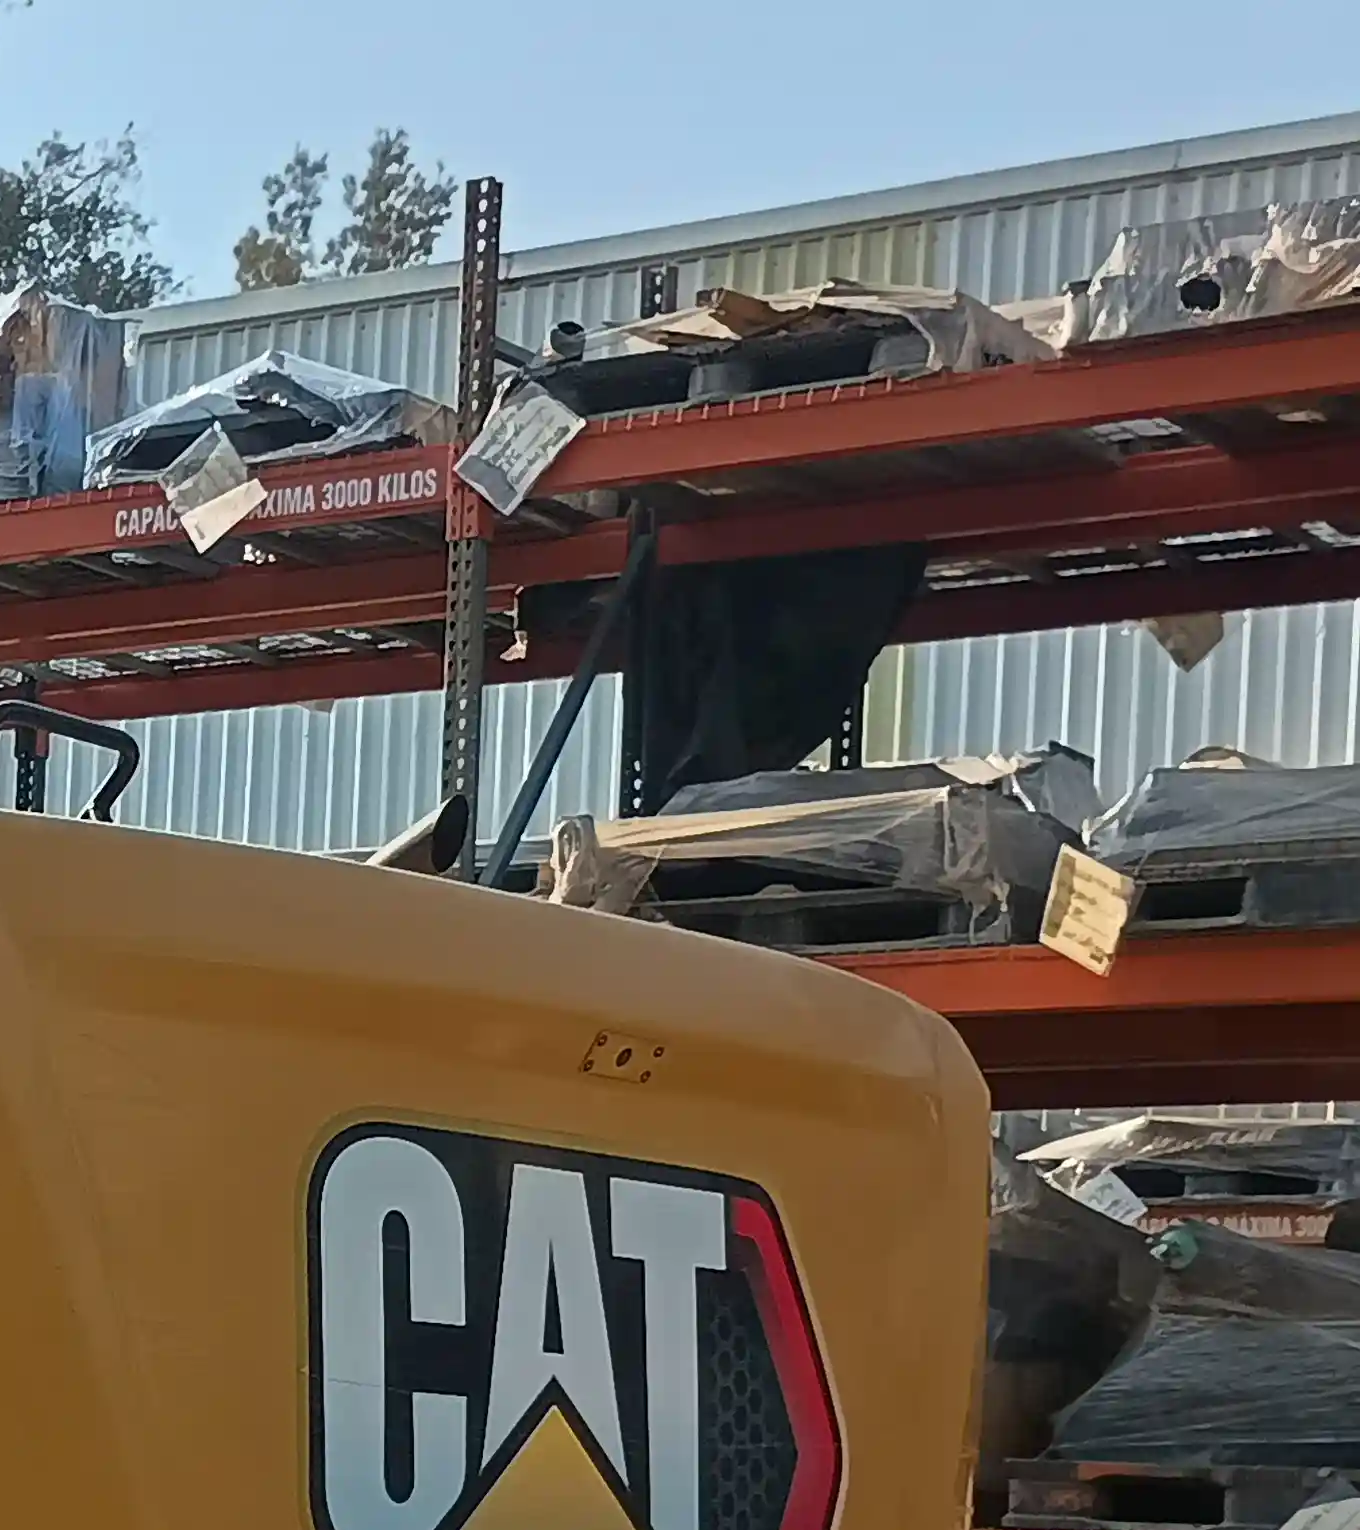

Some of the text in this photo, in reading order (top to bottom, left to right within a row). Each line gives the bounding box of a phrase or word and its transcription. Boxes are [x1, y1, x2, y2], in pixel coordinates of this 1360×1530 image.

[115, 505, 182, 538] CAPAC
[321, 477, 372, 510] 3000
[377, 467, 438, 503] KILOS
